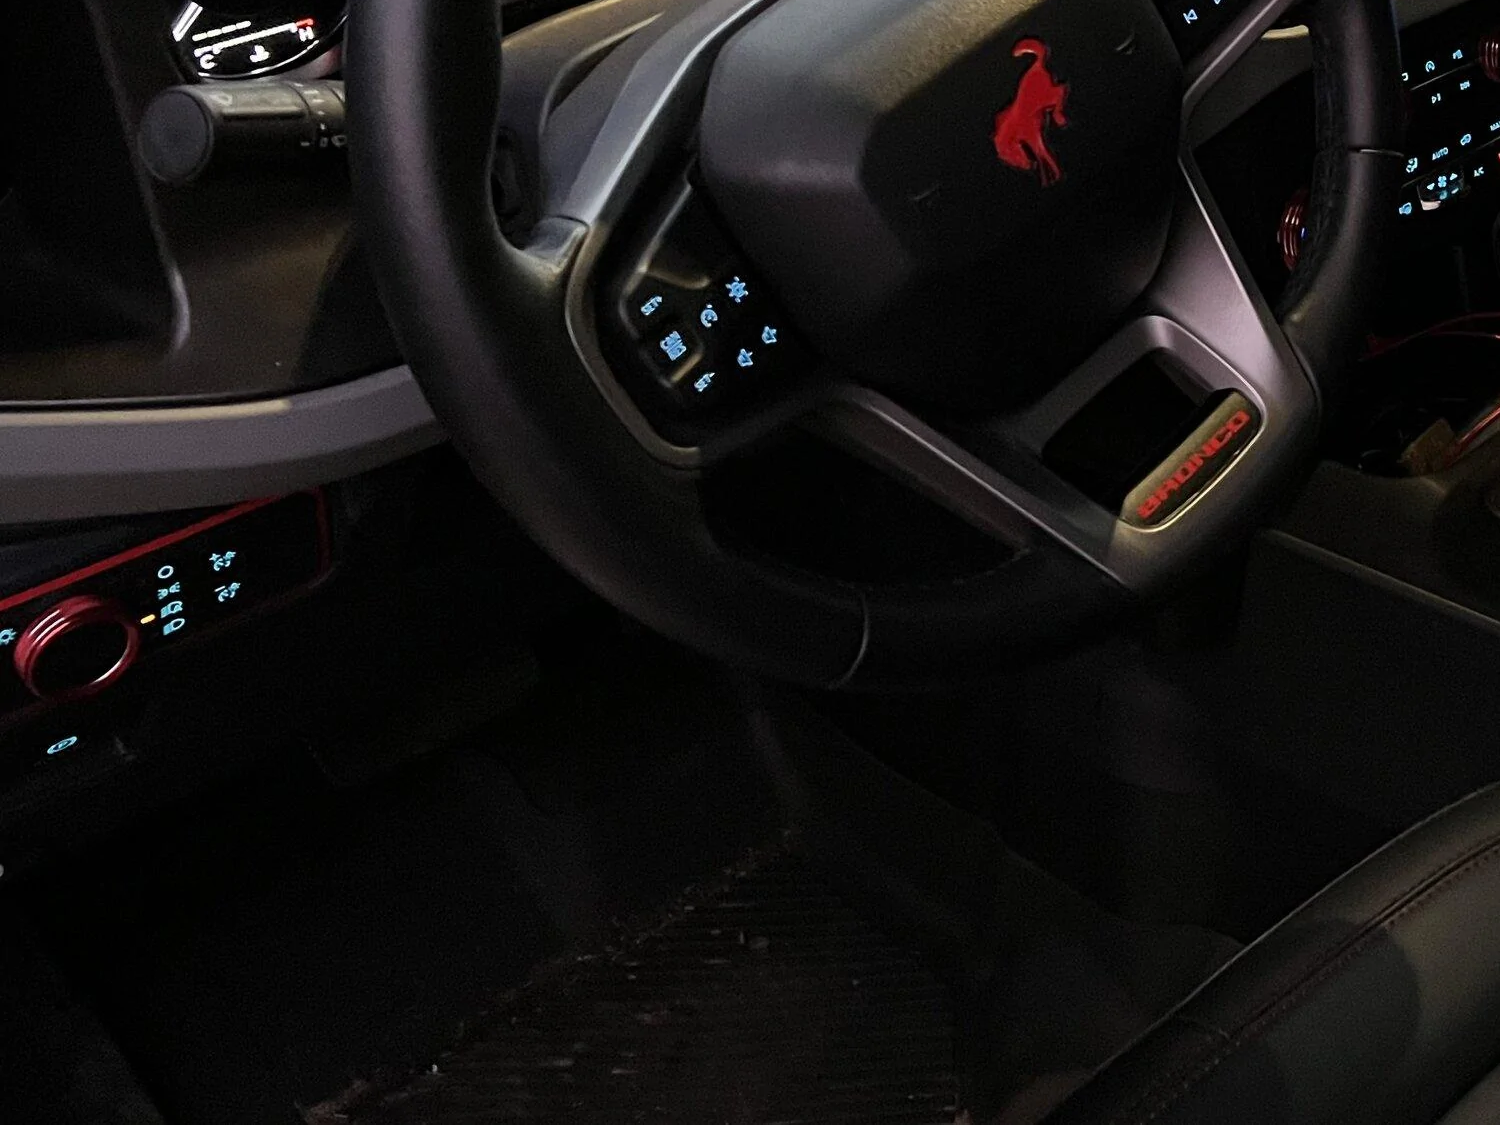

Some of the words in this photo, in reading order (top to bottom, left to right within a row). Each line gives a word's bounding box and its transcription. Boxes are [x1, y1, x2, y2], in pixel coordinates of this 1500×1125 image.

[298, 25, 315, 43] H
[199, 53, 218, 70] C
[1431, 147, 1449, 162] AUTO
[1136, 410, 1251, 519] BRONCO
